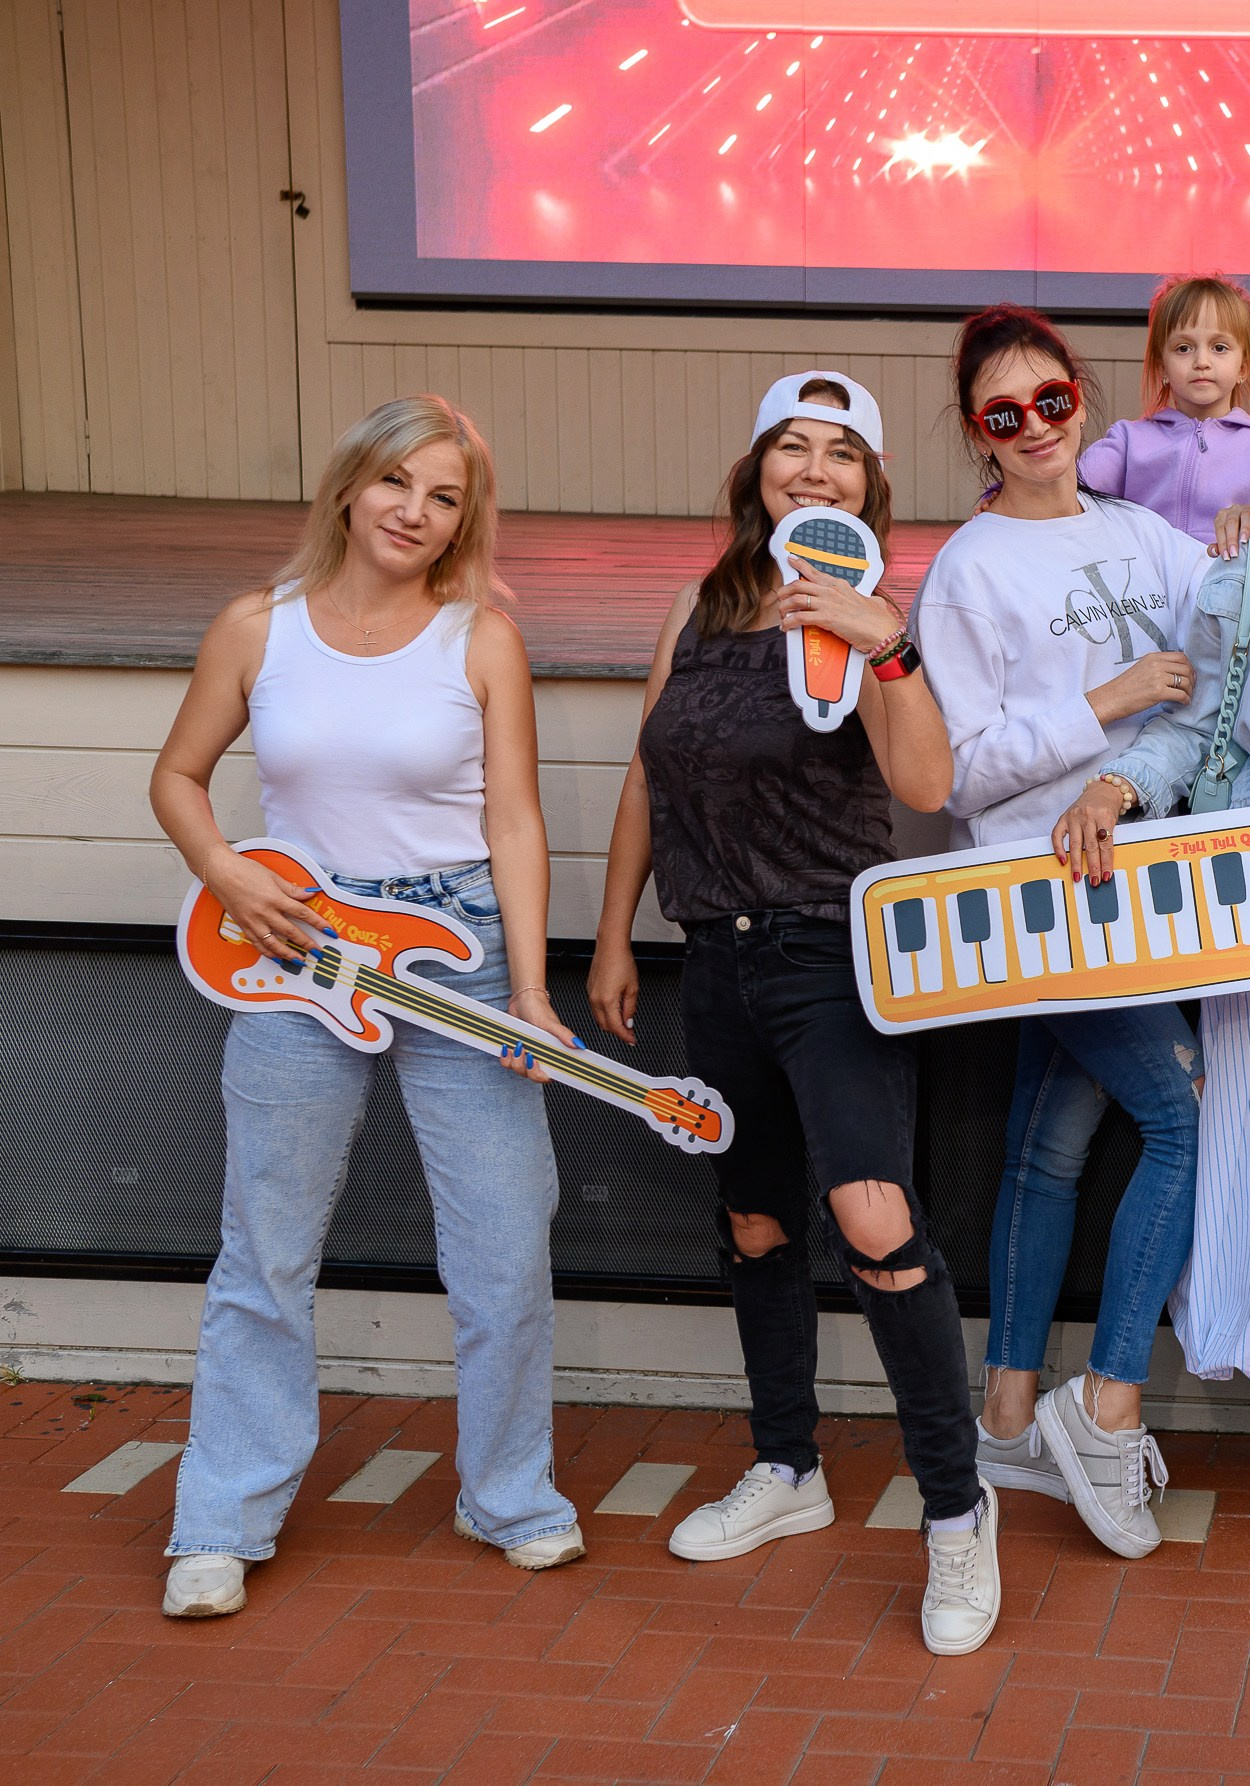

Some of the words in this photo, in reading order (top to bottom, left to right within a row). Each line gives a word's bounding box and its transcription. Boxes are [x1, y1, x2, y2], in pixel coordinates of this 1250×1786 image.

[983, 411, 1019, 431] ТУЦ
[1036, 394, 1073, 416] ТУЦ
[1049, 604, 1109, 636] CALVIN
[1105, 595, 1149, 618] KLEIN
